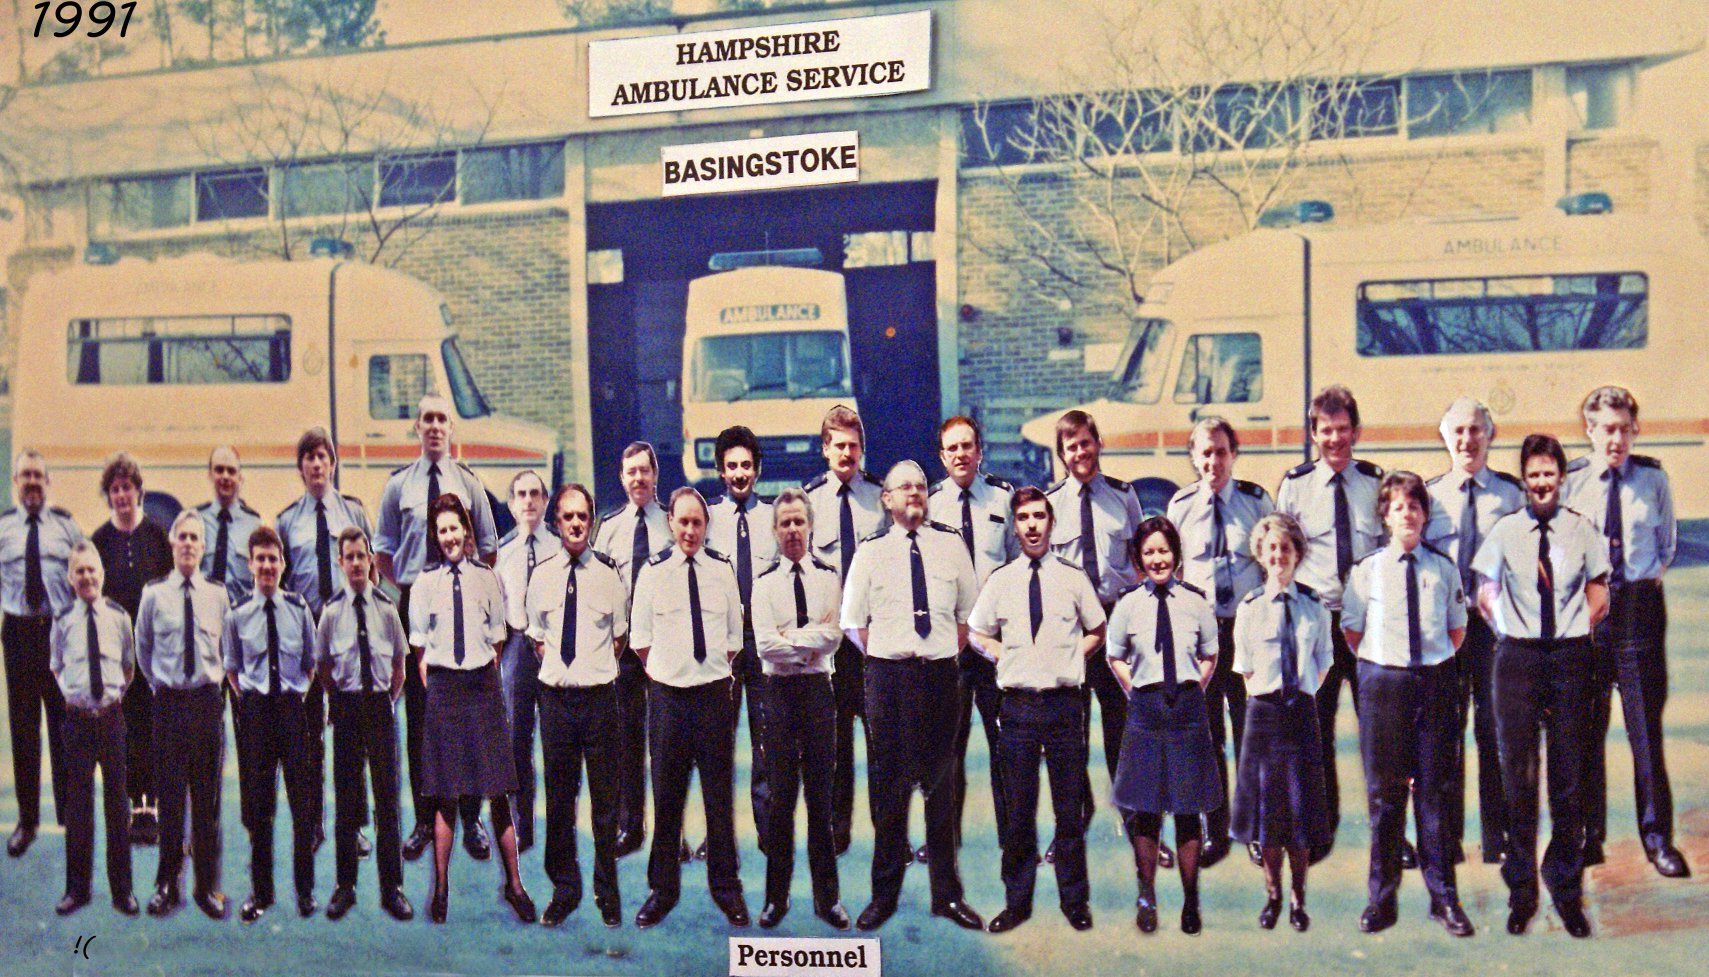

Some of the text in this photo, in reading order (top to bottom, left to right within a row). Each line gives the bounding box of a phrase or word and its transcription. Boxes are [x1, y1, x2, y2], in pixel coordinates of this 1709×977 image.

[676, 30, 840, 65] HAMPSHIRE
[611, 60, 905, 106] AMBULANCE SERVICE
[665, 145, 857, 184] BASINGSTOKE
[1444, 235, 1562, 254] AMBULANCE
[722, 304, 816, 323] AMBULANCE
[738, 945, 867, 968] Personnel
